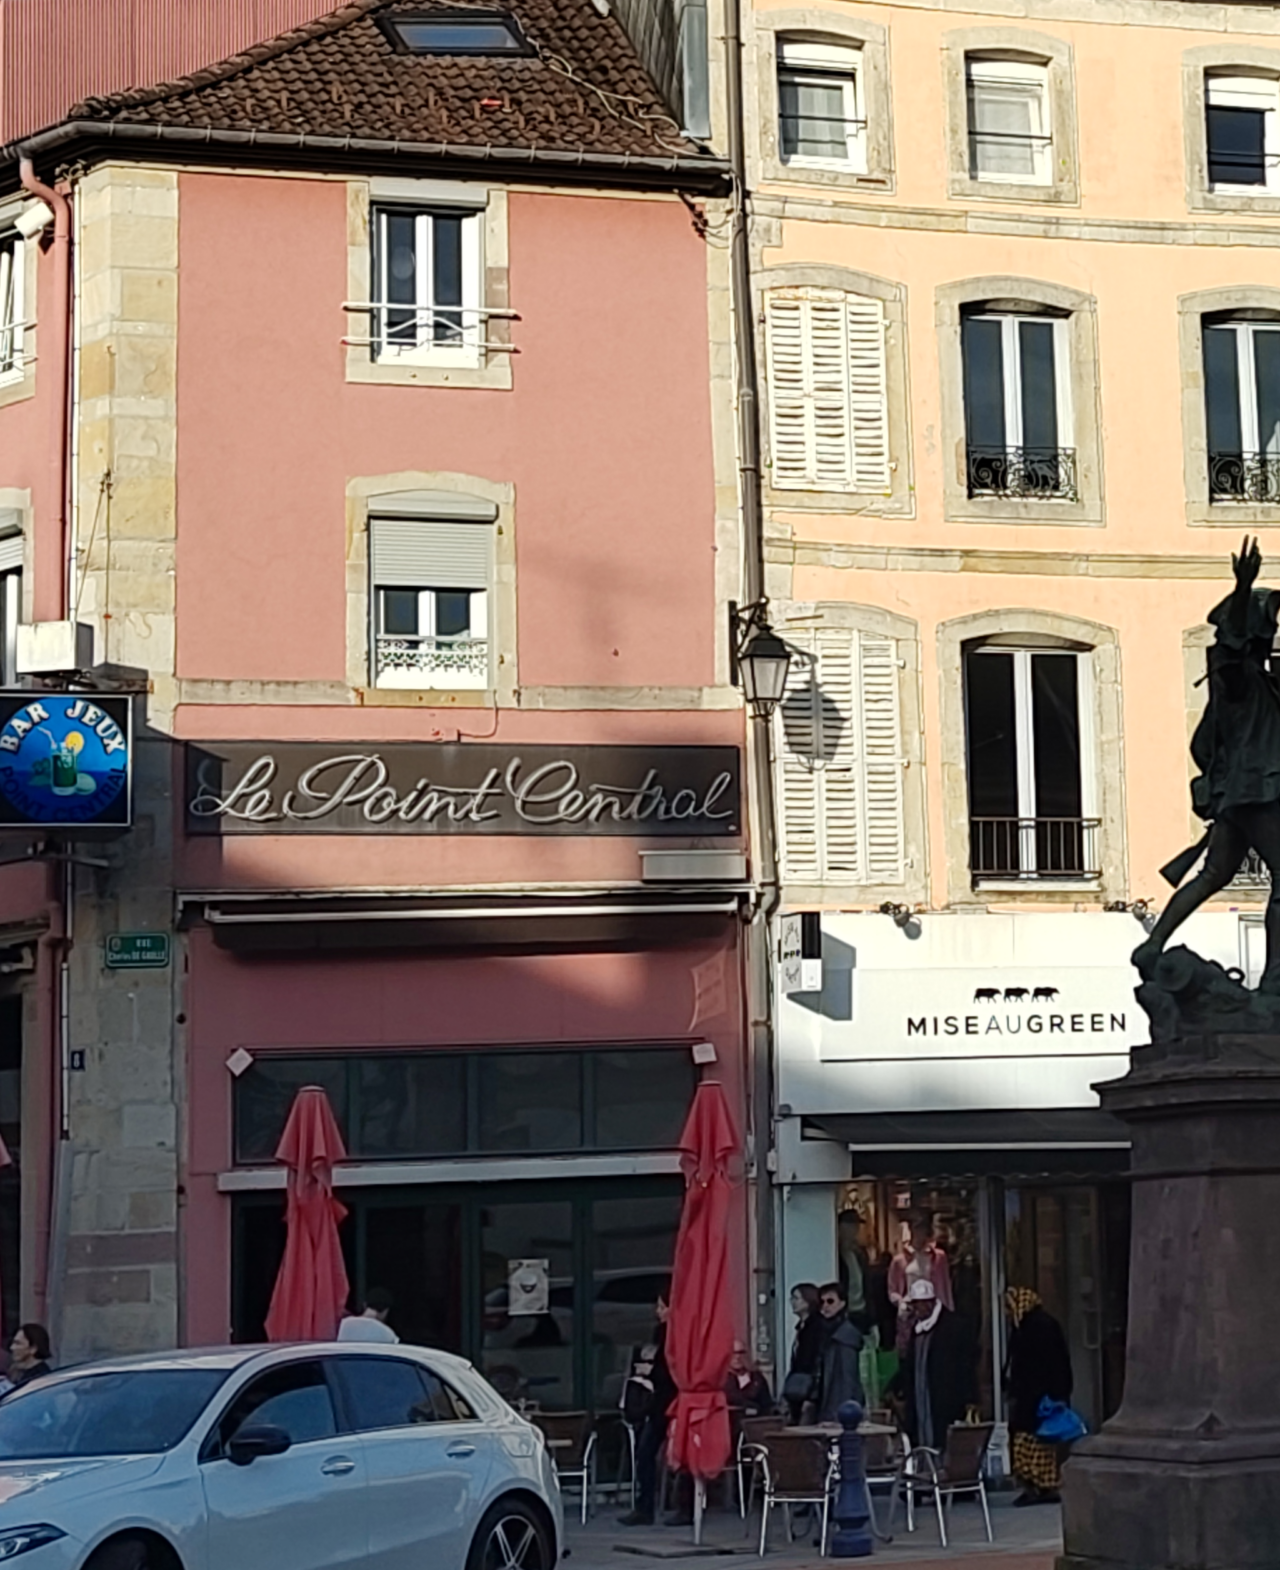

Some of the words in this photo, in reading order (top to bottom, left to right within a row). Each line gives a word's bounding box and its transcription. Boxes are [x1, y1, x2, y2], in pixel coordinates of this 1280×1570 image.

[0, 702, 49, 753] BAR
[66, 700, 125, 754] JEUX
[190, 755, 278, 820] Le
[282, 754, 502, 822] Point
[505, 757, 734, 822] Central
